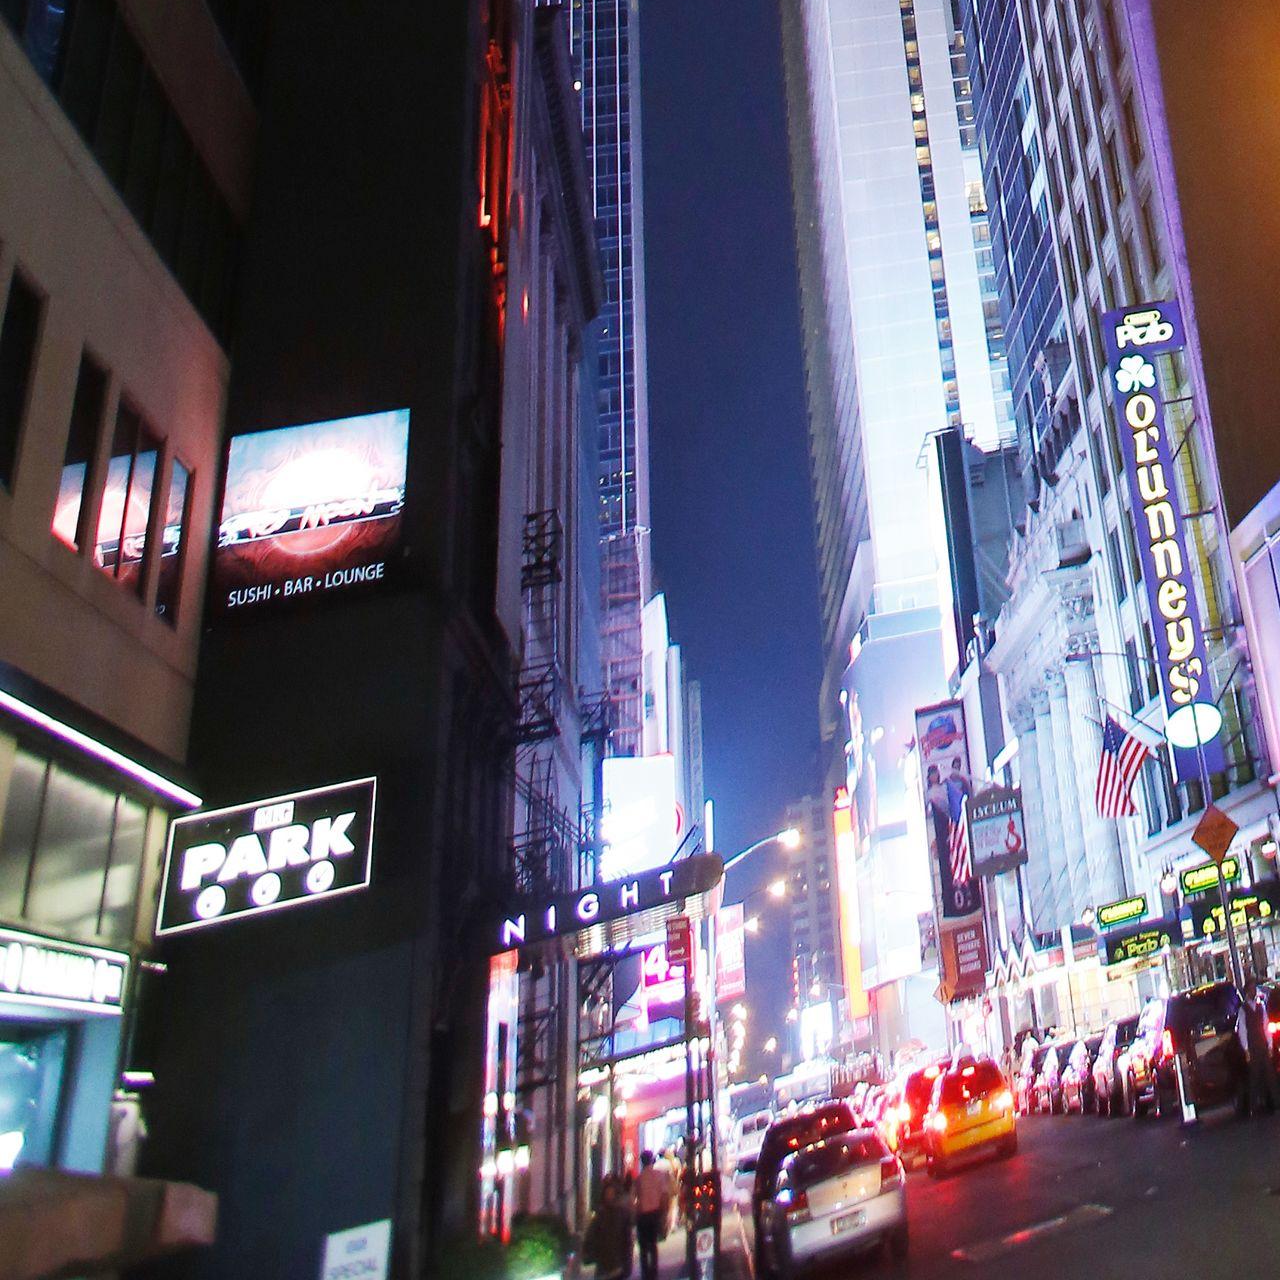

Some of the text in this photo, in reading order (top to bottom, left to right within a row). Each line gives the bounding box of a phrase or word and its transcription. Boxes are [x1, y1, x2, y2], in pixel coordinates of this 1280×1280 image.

[228, 562, 385, 607] SUSHI BAR LOUNGE
[180, 810, 357, 891] PARK
[503, 870, 675, 946] NIGHT
